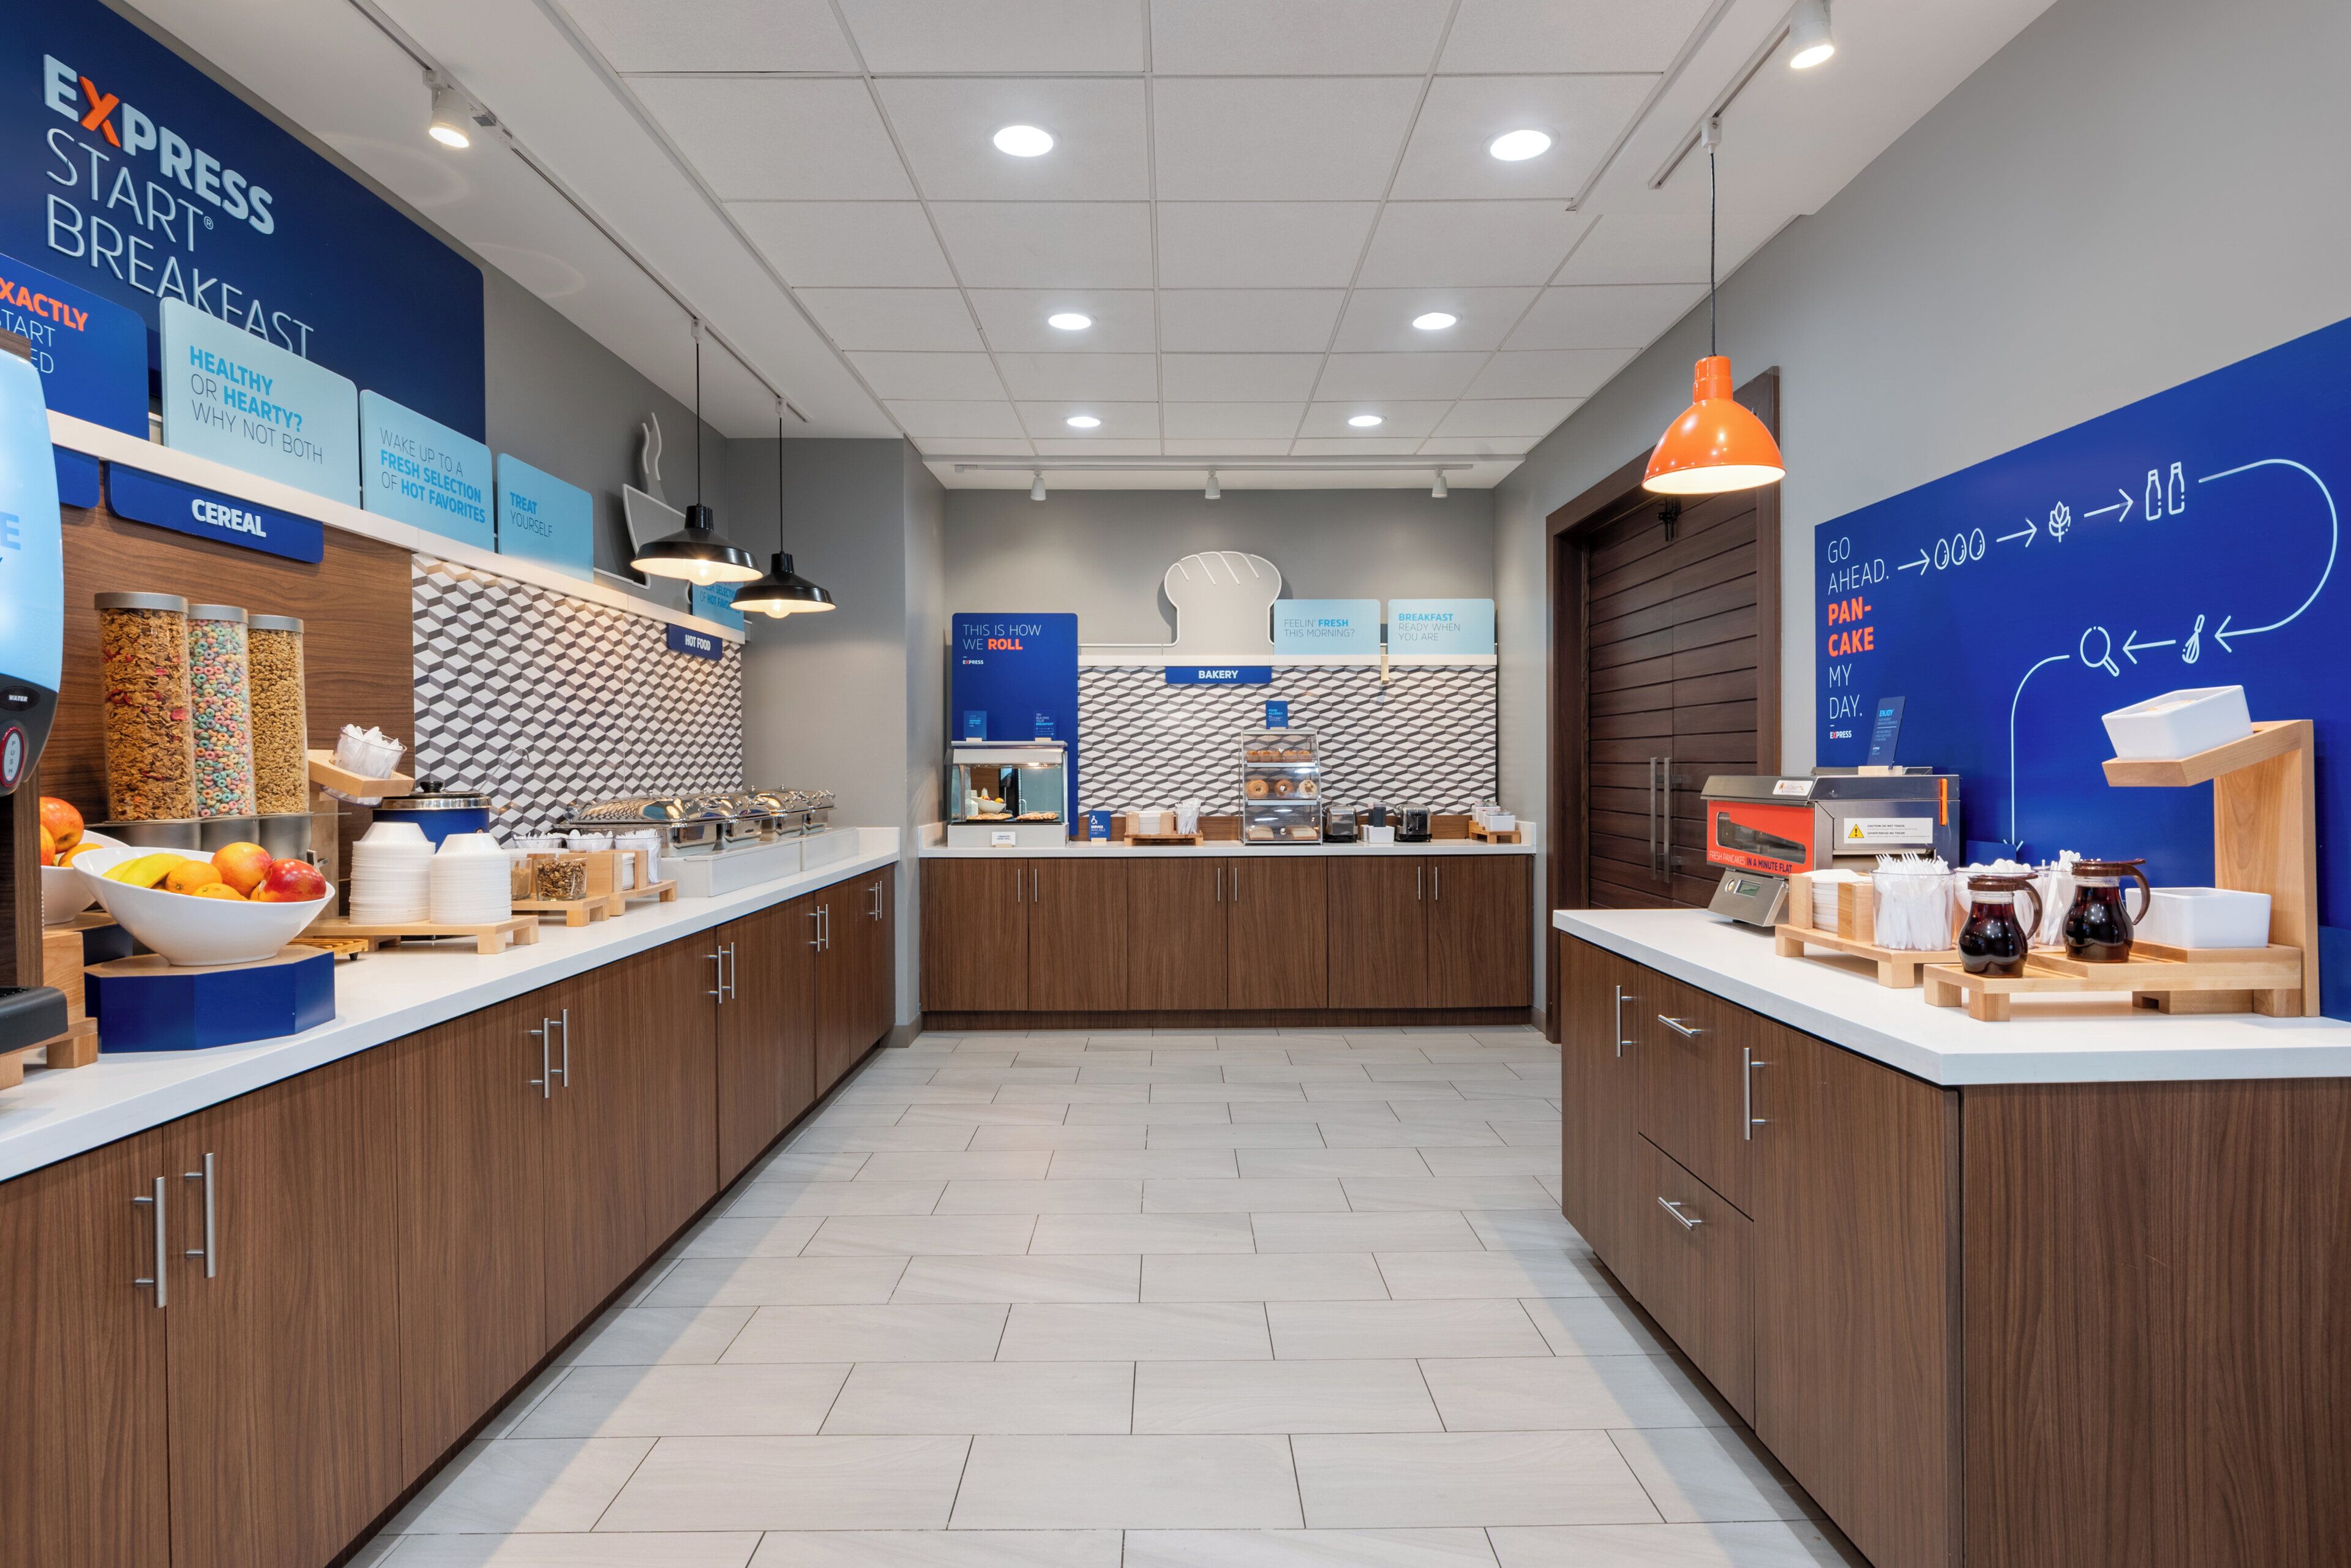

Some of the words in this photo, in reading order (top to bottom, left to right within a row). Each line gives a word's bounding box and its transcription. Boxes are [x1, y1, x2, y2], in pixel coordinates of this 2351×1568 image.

[44, 54, 275, 235] EXPRESS
[48, 193, 314, 358] BREAKFAST
[0, 308, 56, 347] TART
[190, 345, 273, 396] HEALTHY
[191, 373, 217, 401] OR
[223, 385, 302, 432] HEARTY?
[192, 399, 236, 433] WHY
[244, 419, 276, 447] NOT
[282, 433, 323, 464] BOTH
[380, 427, 416, 457] WAKE
[419, 445, 435, 463] UP
[438, 452, 452, 472] TO
[456, 462, 463, 478] A
[381, 449, 420, 479] FRESH
[424, 467, 482, 503] SELECTION
[381, 471, 397, 490] OF
[401, 478, 426, 501] HOT
[429, 489, 486, 524] FAVORITES
[509, 492, 538, 515] TREAT
[192, 498, 267, 538] CEREAL
[510, 509, 553, 539] YOURSELF
[1828, 536, 1850, 563] GO
[1828, 558, 1889, 595] AHEAD.
[707, 594, 717, 606] HOT
[1828, 596, 1872, 626] PAN-
[962, 624, 990, 636] THIS
[994, 624, 1005, 636] IS
[1010, 624, 1042, 636] HOW
[1398, 613, 1453, 621] BREAKFAST
[1399, 623, 1429, 631] READY
[685, 634, 696, 648] HOT
[697, 637, 711, 651] FOOD
[962, 639, 983, 650] WE
[987, 638, 1024, 650] ROLL
[1284, 629, 1304, 637] THIS
[1307, 629, 1355, 637] MORNING?
[1828, 626, 1874, 658] CAKE
[1198, 670, 1239, 679] BAKERY
[1829, 663, 1852, 688] MY
[1829, 694, 1862, 719] DAY.
[1829, 730, 1853, 739] EXPRESS
[1709, 850, 1723, 860] FRESH
[1722, 852, 1745, 866] PANCAKES
[1746, 857, 1752, 867] IN
[1753, 858, 1757, 867] A
[1758, 859, 1778, 871] MINUTE
[1779, 863, 1793, 874] FLAT
